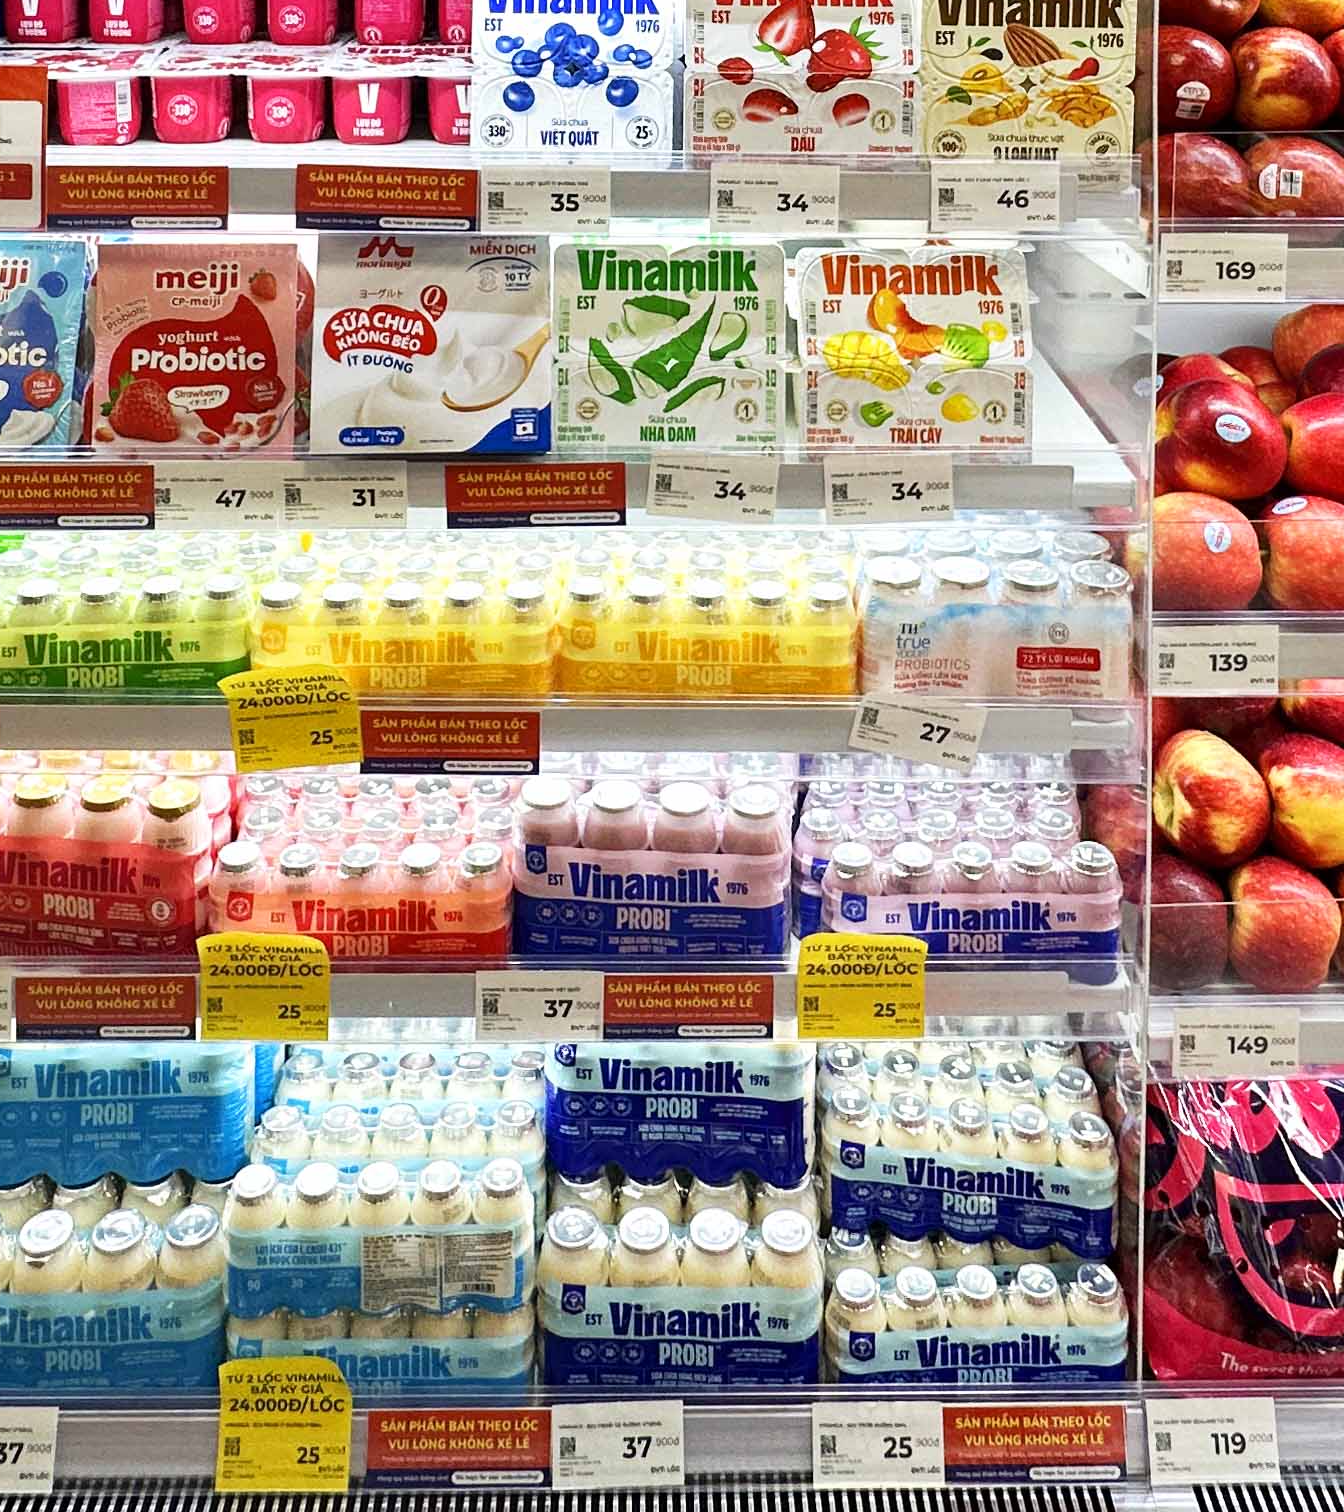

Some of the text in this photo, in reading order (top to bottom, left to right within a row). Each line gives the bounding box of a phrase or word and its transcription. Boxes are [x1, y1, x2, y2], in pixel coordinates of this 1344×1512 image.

[577, 249, 758, 293] Vinamilk
[822, 254, 1001, 298] Vinamilk
[129, 346, 266, 374] Probiotic
[24, 630, 172, 664] Vinamilk
[67, 666, 125, 689] PROBI
[569, 862, 720, 905] Vinamilk
[599, 1058, 744, 1094] Vinamilk
[79, 1104, 135, 1127] PROBI
[645, 1097, 699, 1120] PROBI
[1220, 1352, 1254, 1373] The
[1258, 1359, 1297, 1375] sweet
[1301, 1358, 1335, 1377] thing
